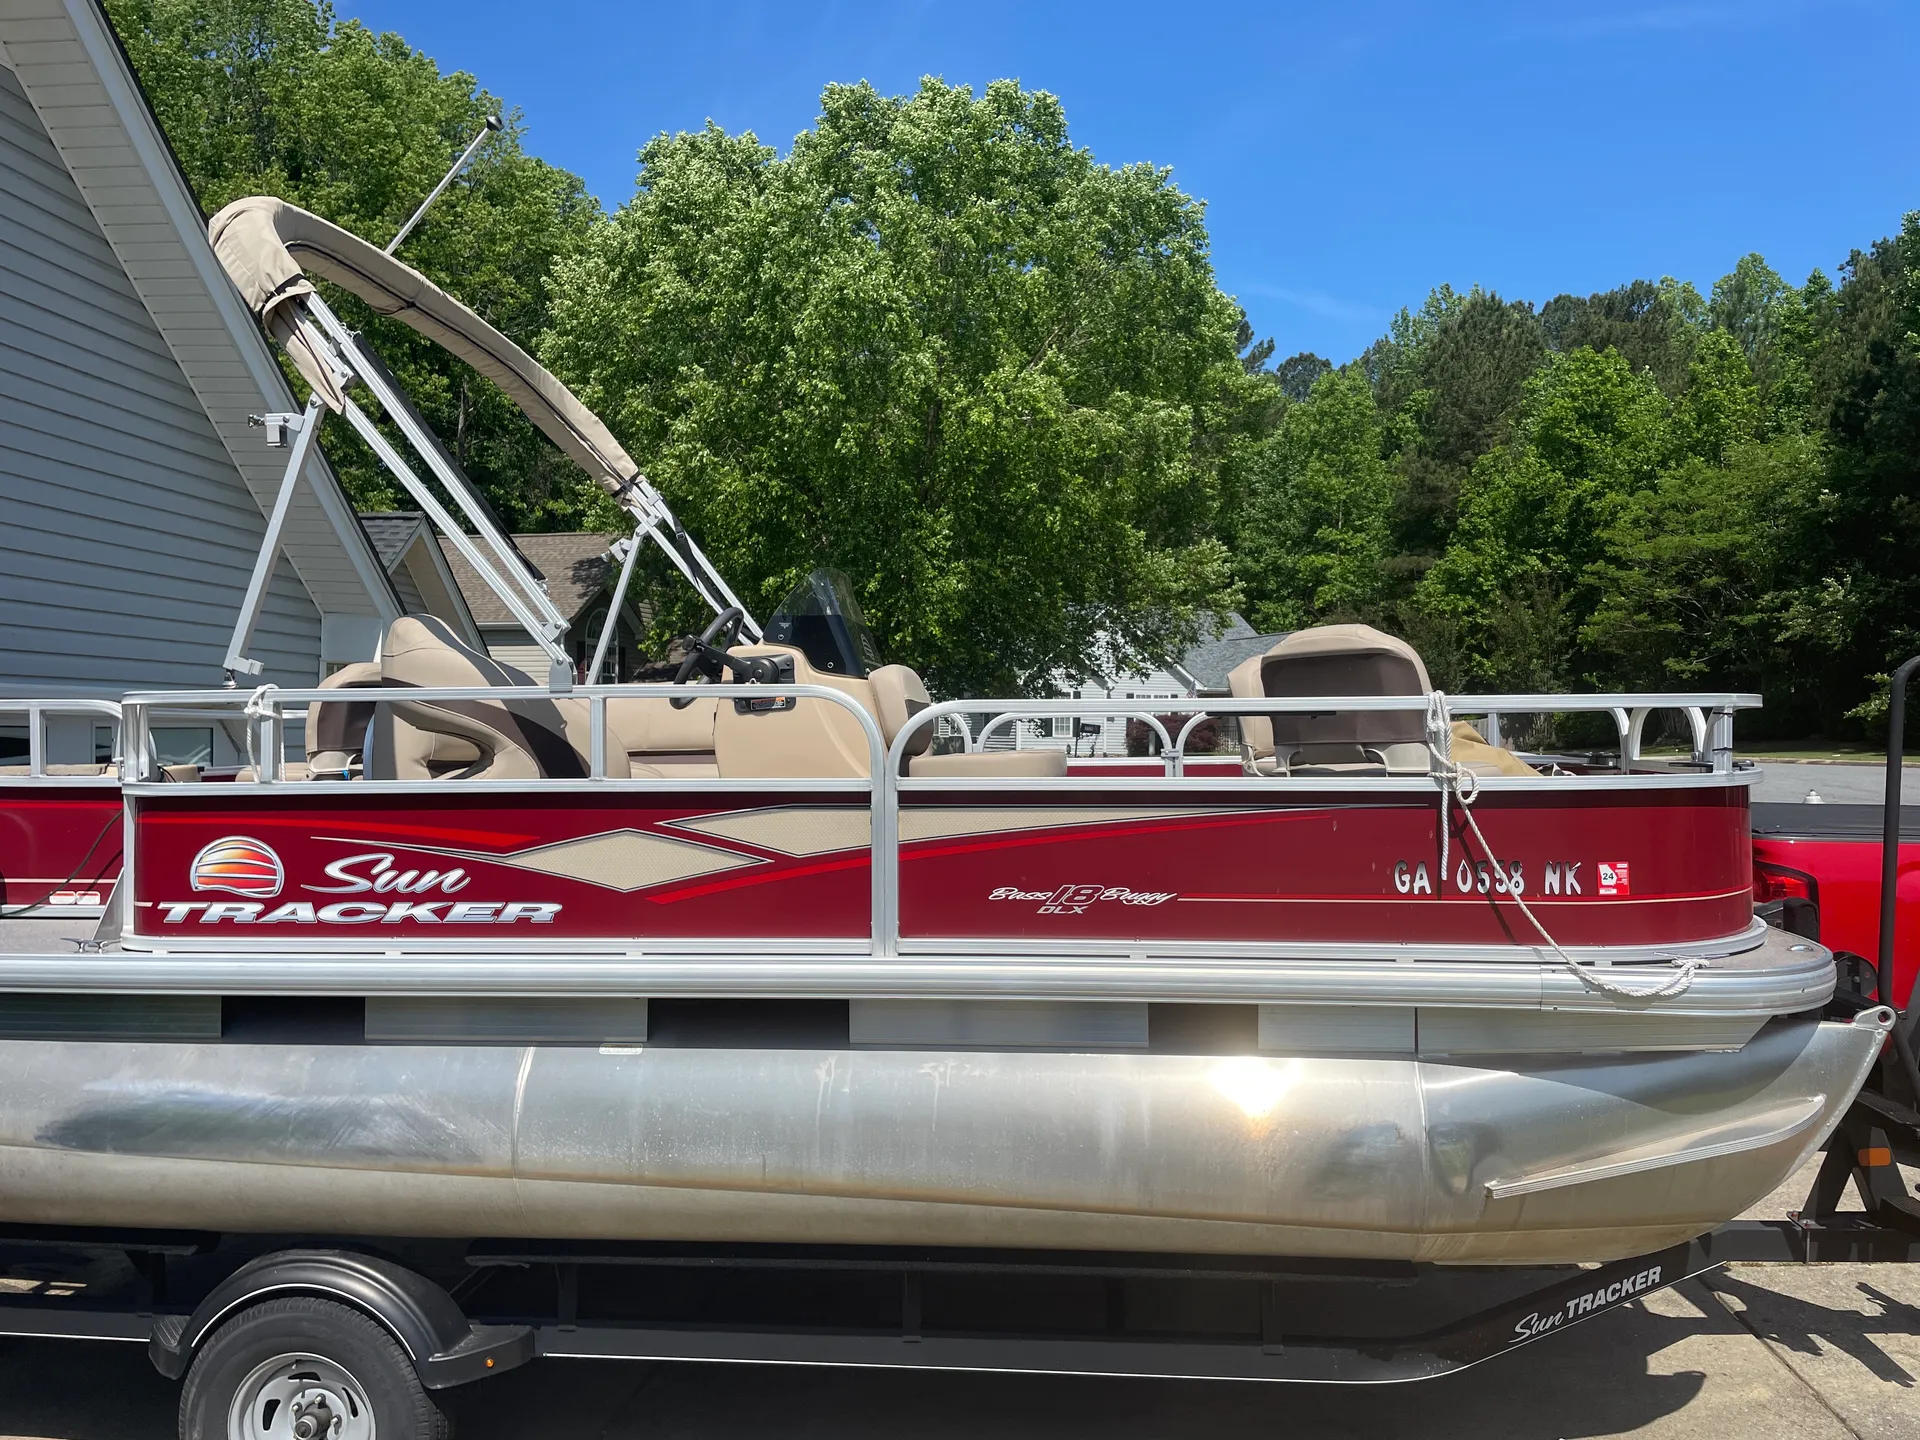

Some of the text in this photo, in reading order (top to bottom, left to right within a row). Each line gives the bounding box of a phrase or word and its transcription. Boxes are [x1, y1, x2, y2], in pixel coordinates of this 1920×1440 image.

[300, 853, 471, 894] Sun
[1394, 861, 1432, 895] GA
[1544, 861, 1582, 895] NK
[1602, 872, 1615, 881] 24
[988, 884, 1178, 906] Bass 18 Buggy
[157, 901, 563, 925] TRACKER
[1036, 905, 1089, 914] DLX
[1508, 1265, 1662, 1343] Sun TRACKER
